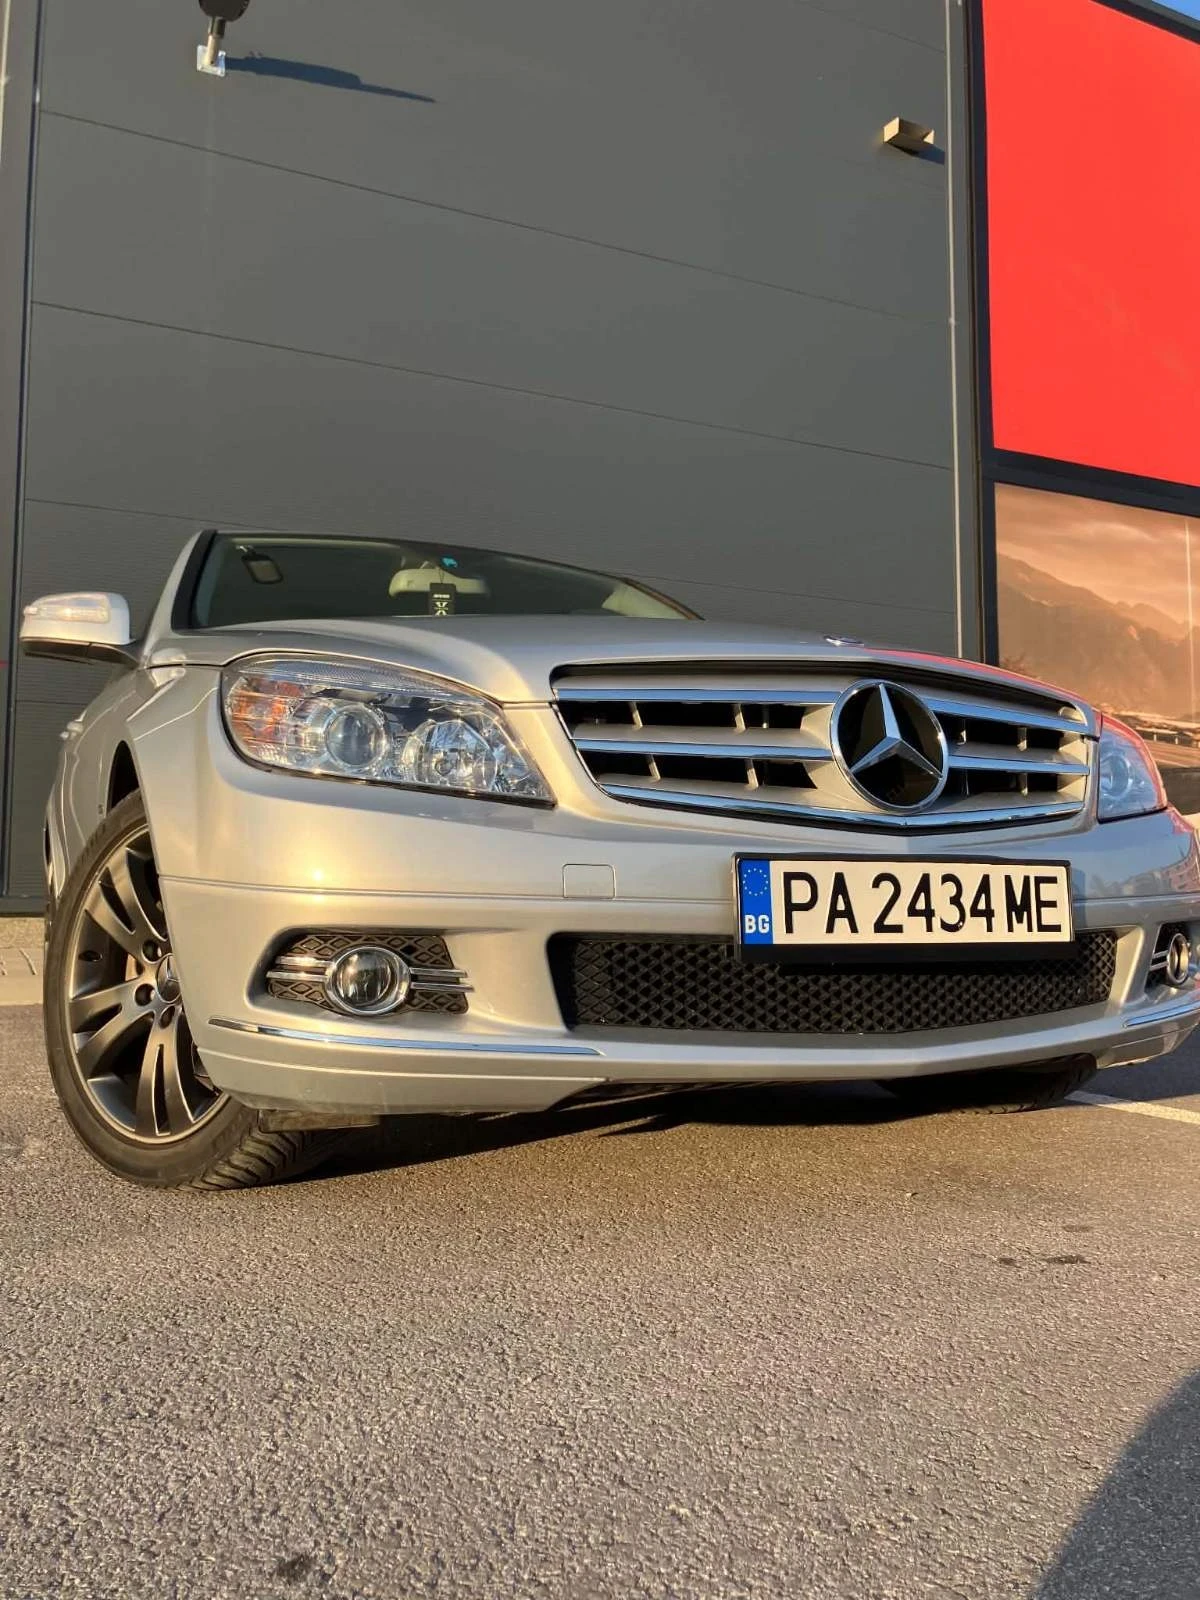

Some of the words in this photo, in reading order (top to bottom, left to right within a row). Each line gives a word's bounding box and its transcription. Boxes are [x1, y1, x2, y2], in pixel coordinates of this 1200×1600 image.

[782, 871, 859, 934] PA
[871, 872, 995, 934] 2434
[1004, 874, 1062, 933] ME
[744, 914, 770, 934] BG
